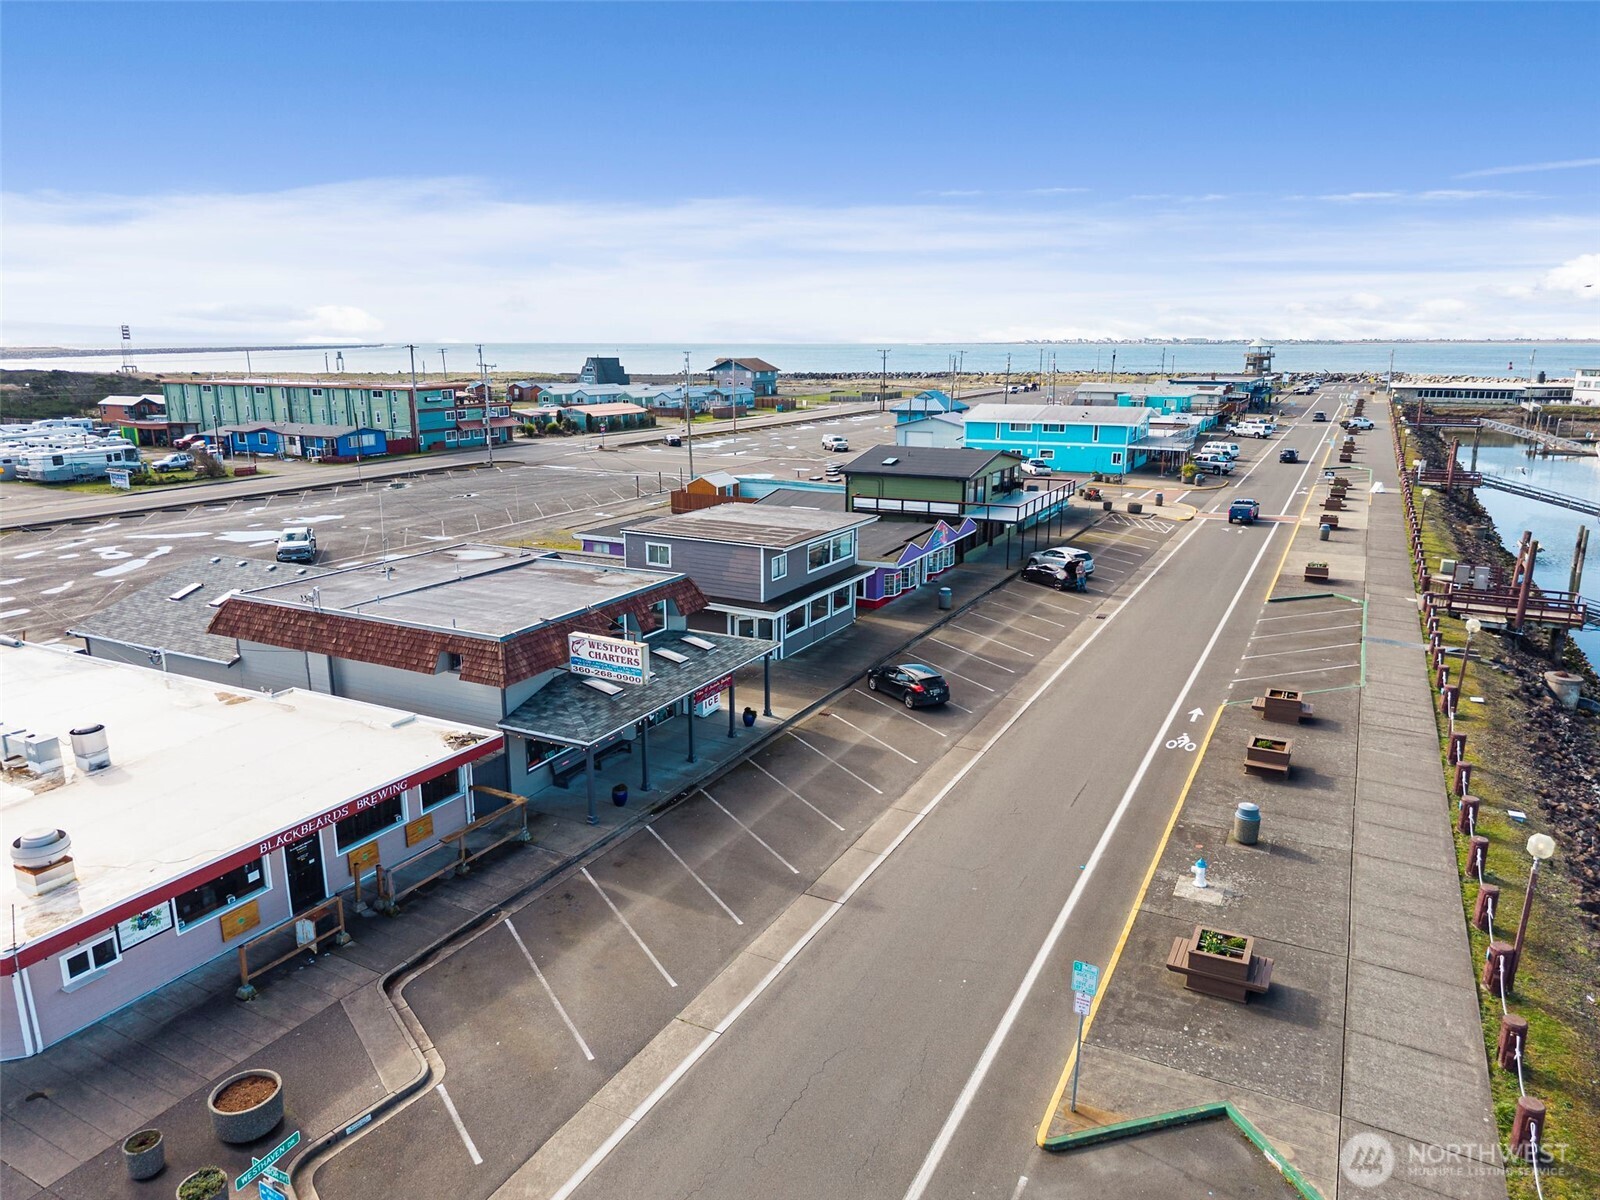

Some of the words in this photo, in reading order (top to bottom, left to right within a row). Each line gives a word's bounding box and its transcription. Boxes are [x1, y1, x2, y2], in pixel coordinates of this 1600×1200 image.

[588, 640, 640, 656] WESTPORT
[588, 651, 640, 667] CHARTERS
[572, 665, 641, 683] 360-268-0900
[704, 694, 719, 709] ICE
[259, 805, 350, 855] BLACKBEARDS
[356, 779, 408, 810] BREWING
[240, 1145, 285, 1184] WESTHAVEN
[287, 1138, 295, 1148] DR
